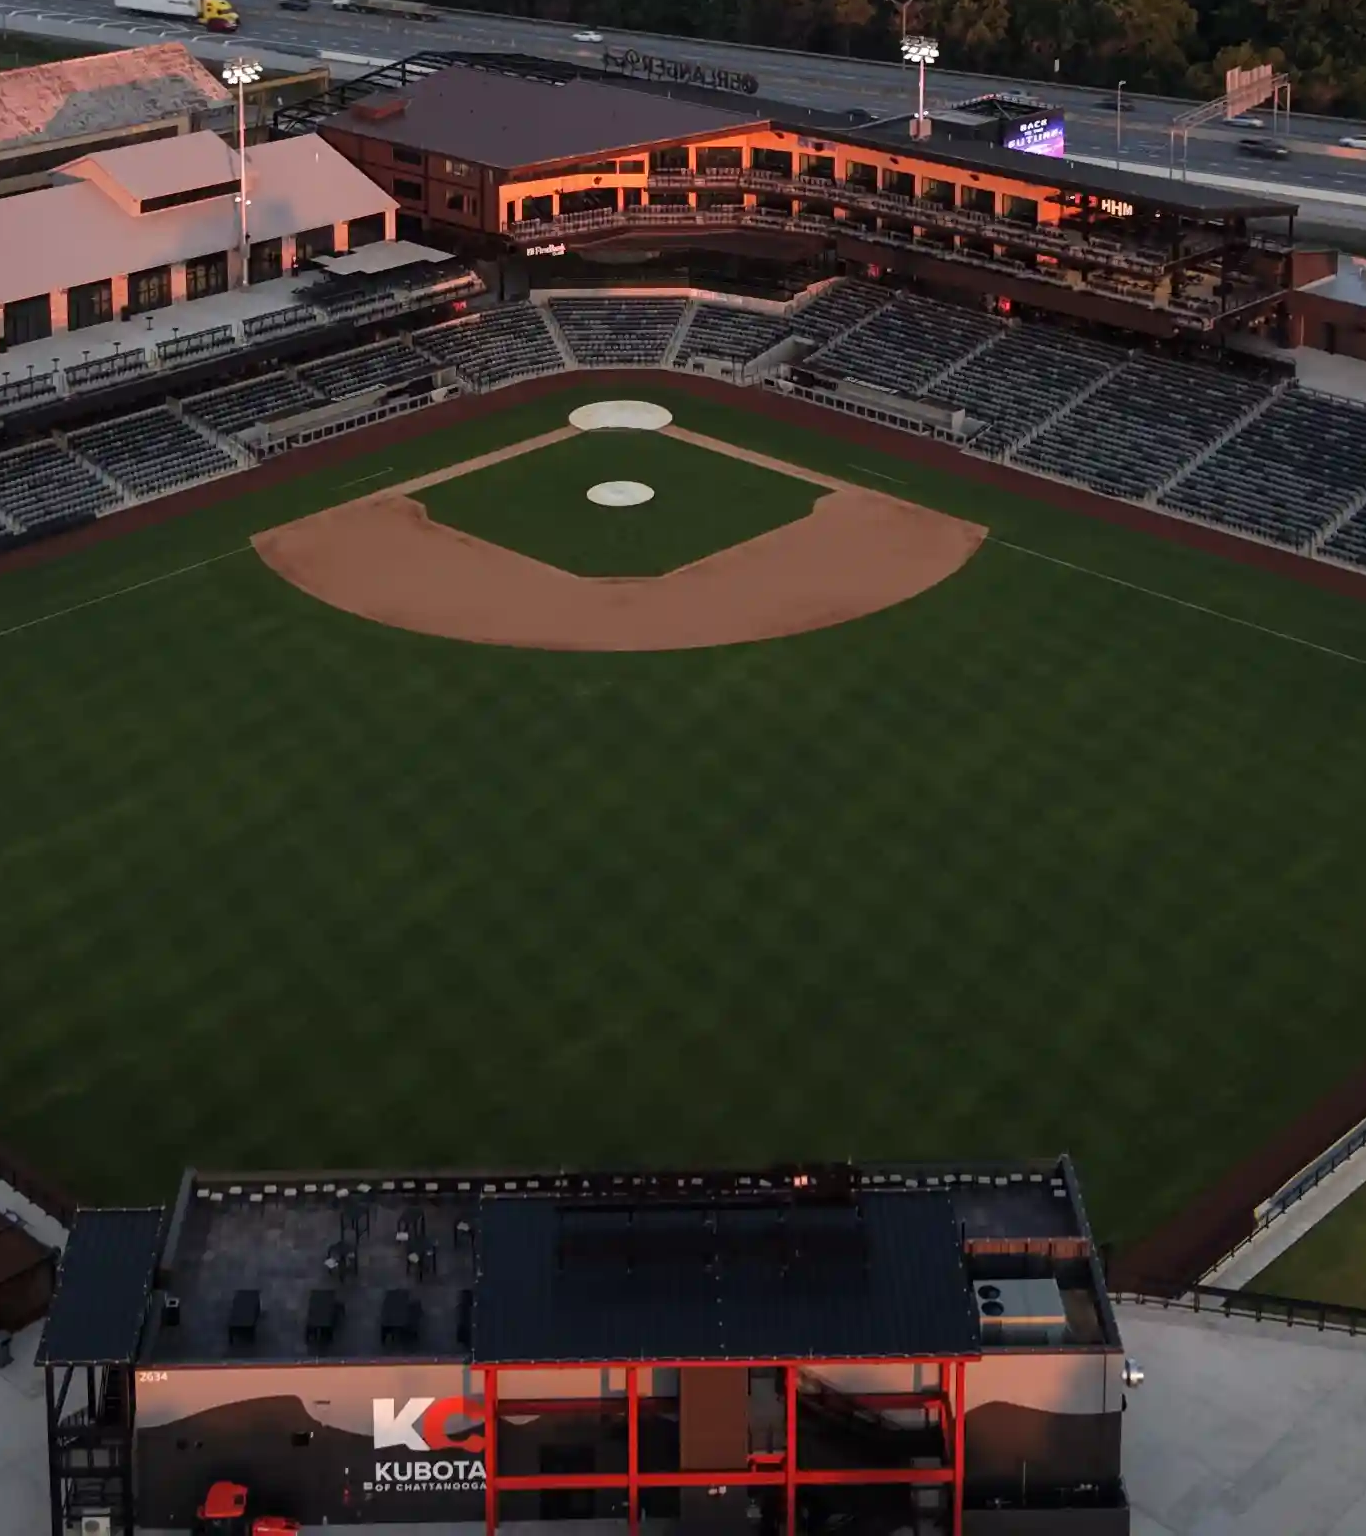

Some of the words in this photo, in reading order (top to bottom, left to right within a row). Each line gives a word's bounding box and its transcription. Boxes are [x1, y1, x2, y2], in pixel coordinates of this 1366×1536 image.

[1019, 118, 1048, 132] BACK
[375, 1460, 487, 1482] KUBOTA
[375, 1483, 391, 1492] OF
[395, 1482, 487, 1492] CHATTANOOGA
